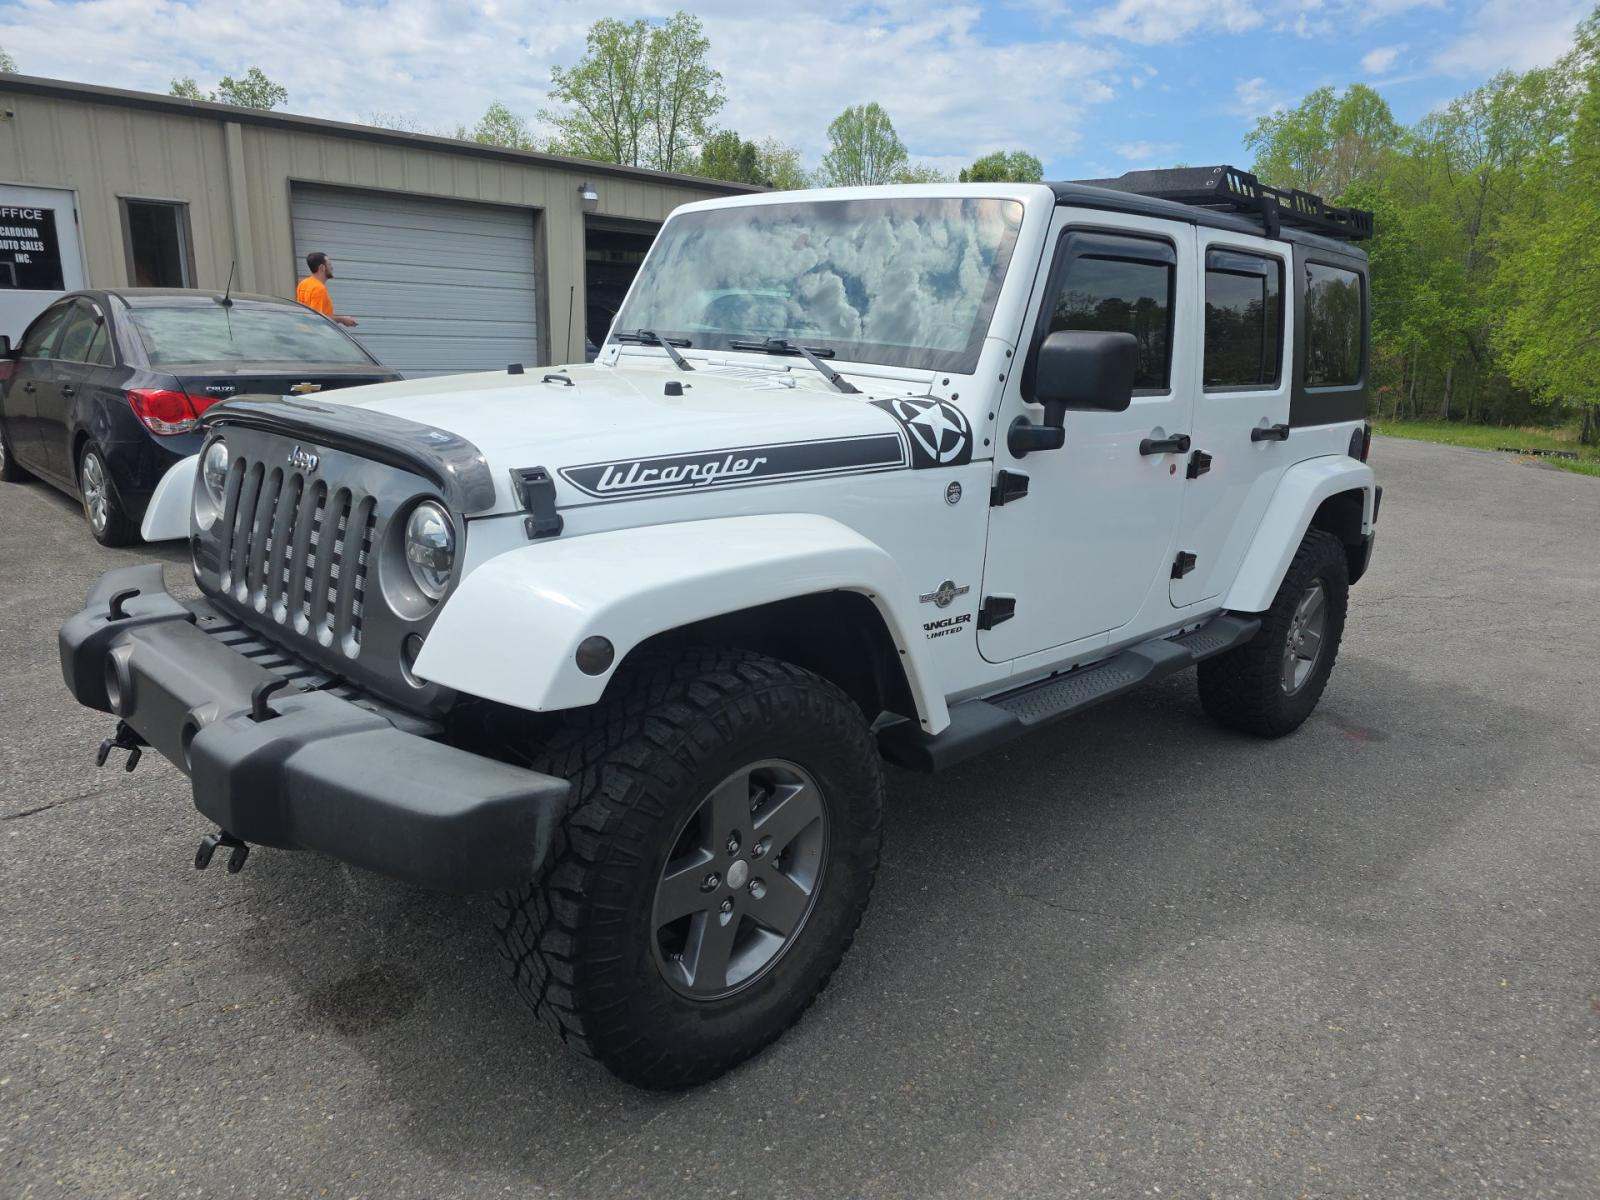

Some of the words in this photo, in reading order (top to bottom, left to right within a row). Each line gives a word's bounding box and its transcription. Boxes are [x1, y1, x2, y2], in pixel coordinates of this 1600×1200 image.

[0, 207, 43, 220] FFICE
[0, 226, 39, 238] CAROLINA
[0, 240, 19, 250] AUTO
[20, 241, 44, 251] SALES
[15, 253, 33, 264] INC.
[596, 455, 767, 490] Wrangler
